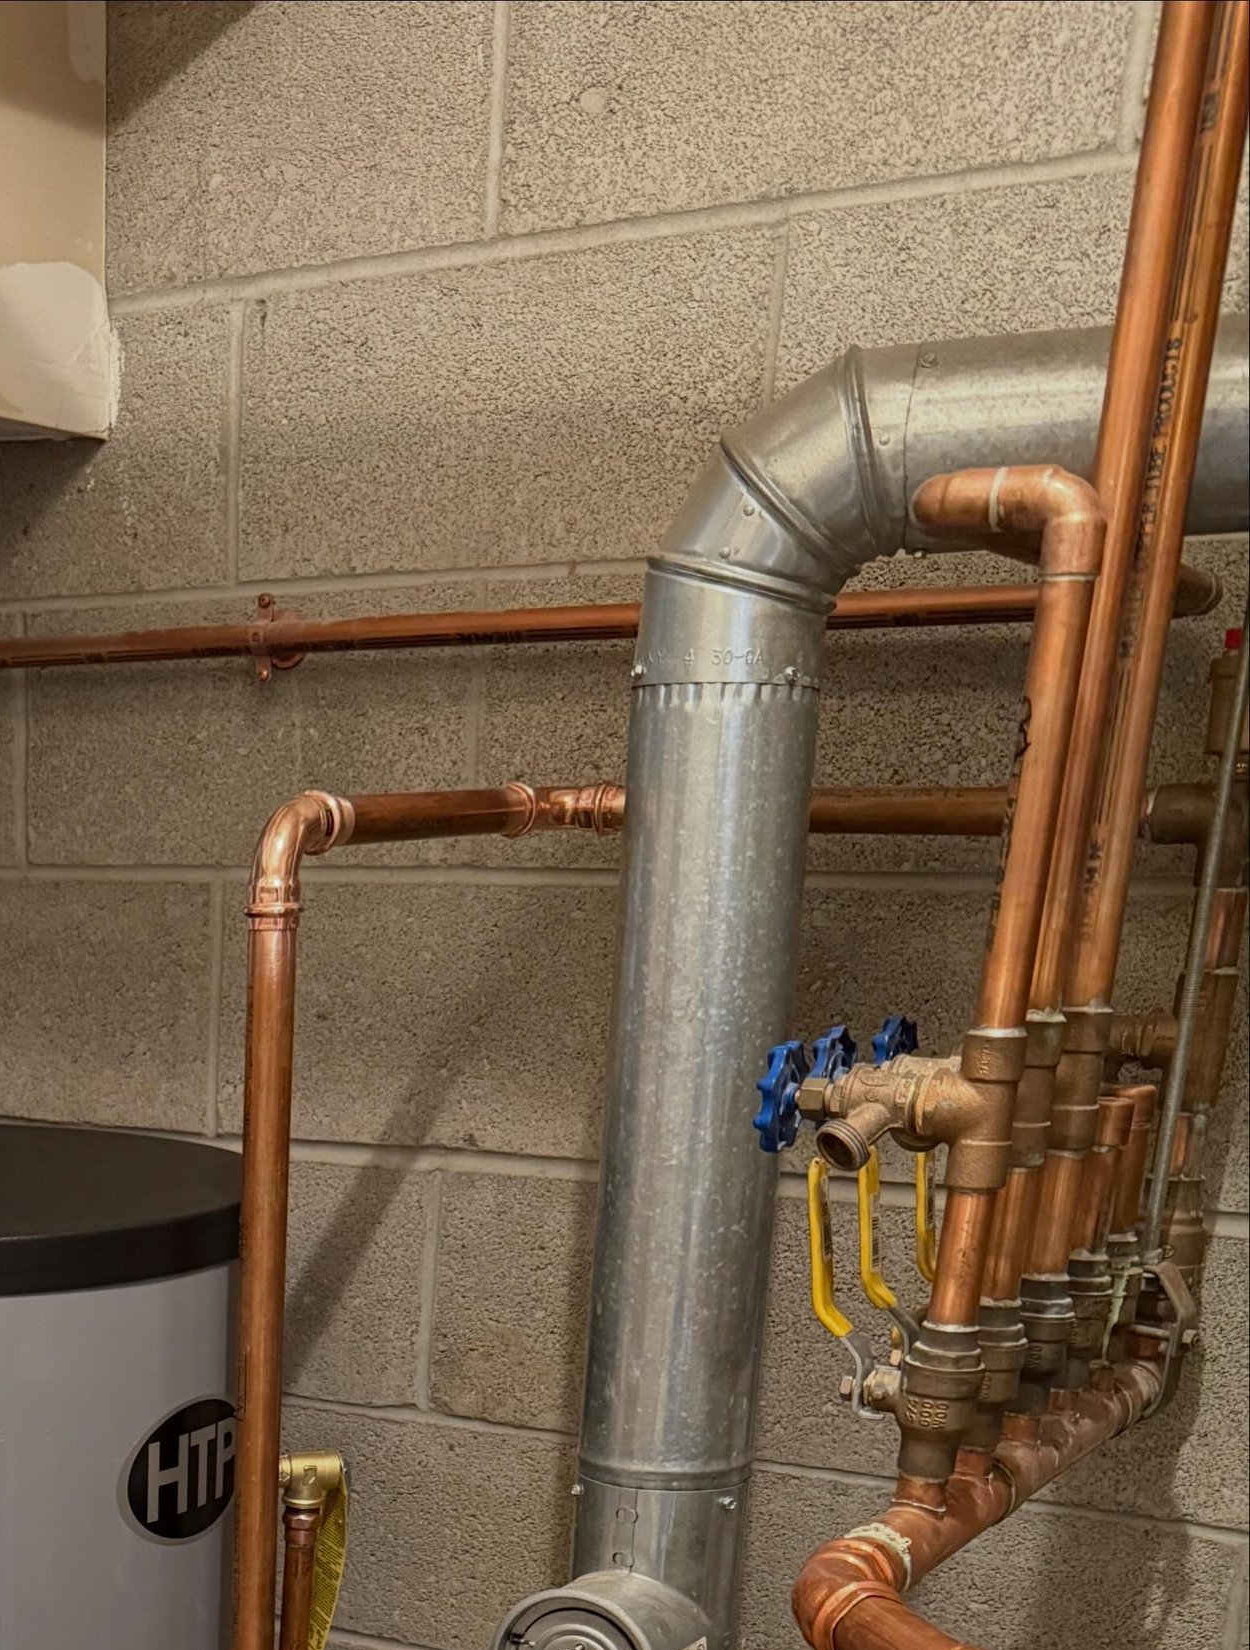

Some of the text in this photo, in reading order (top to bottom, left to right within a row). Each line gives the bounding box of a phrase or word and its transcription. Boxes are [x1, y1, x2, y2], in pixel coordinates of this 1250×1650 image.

[683, 649, 695, 665] 4
[932, 1401, 949, 1429] WOG
[147, 1416, 237, 1524] HTP
